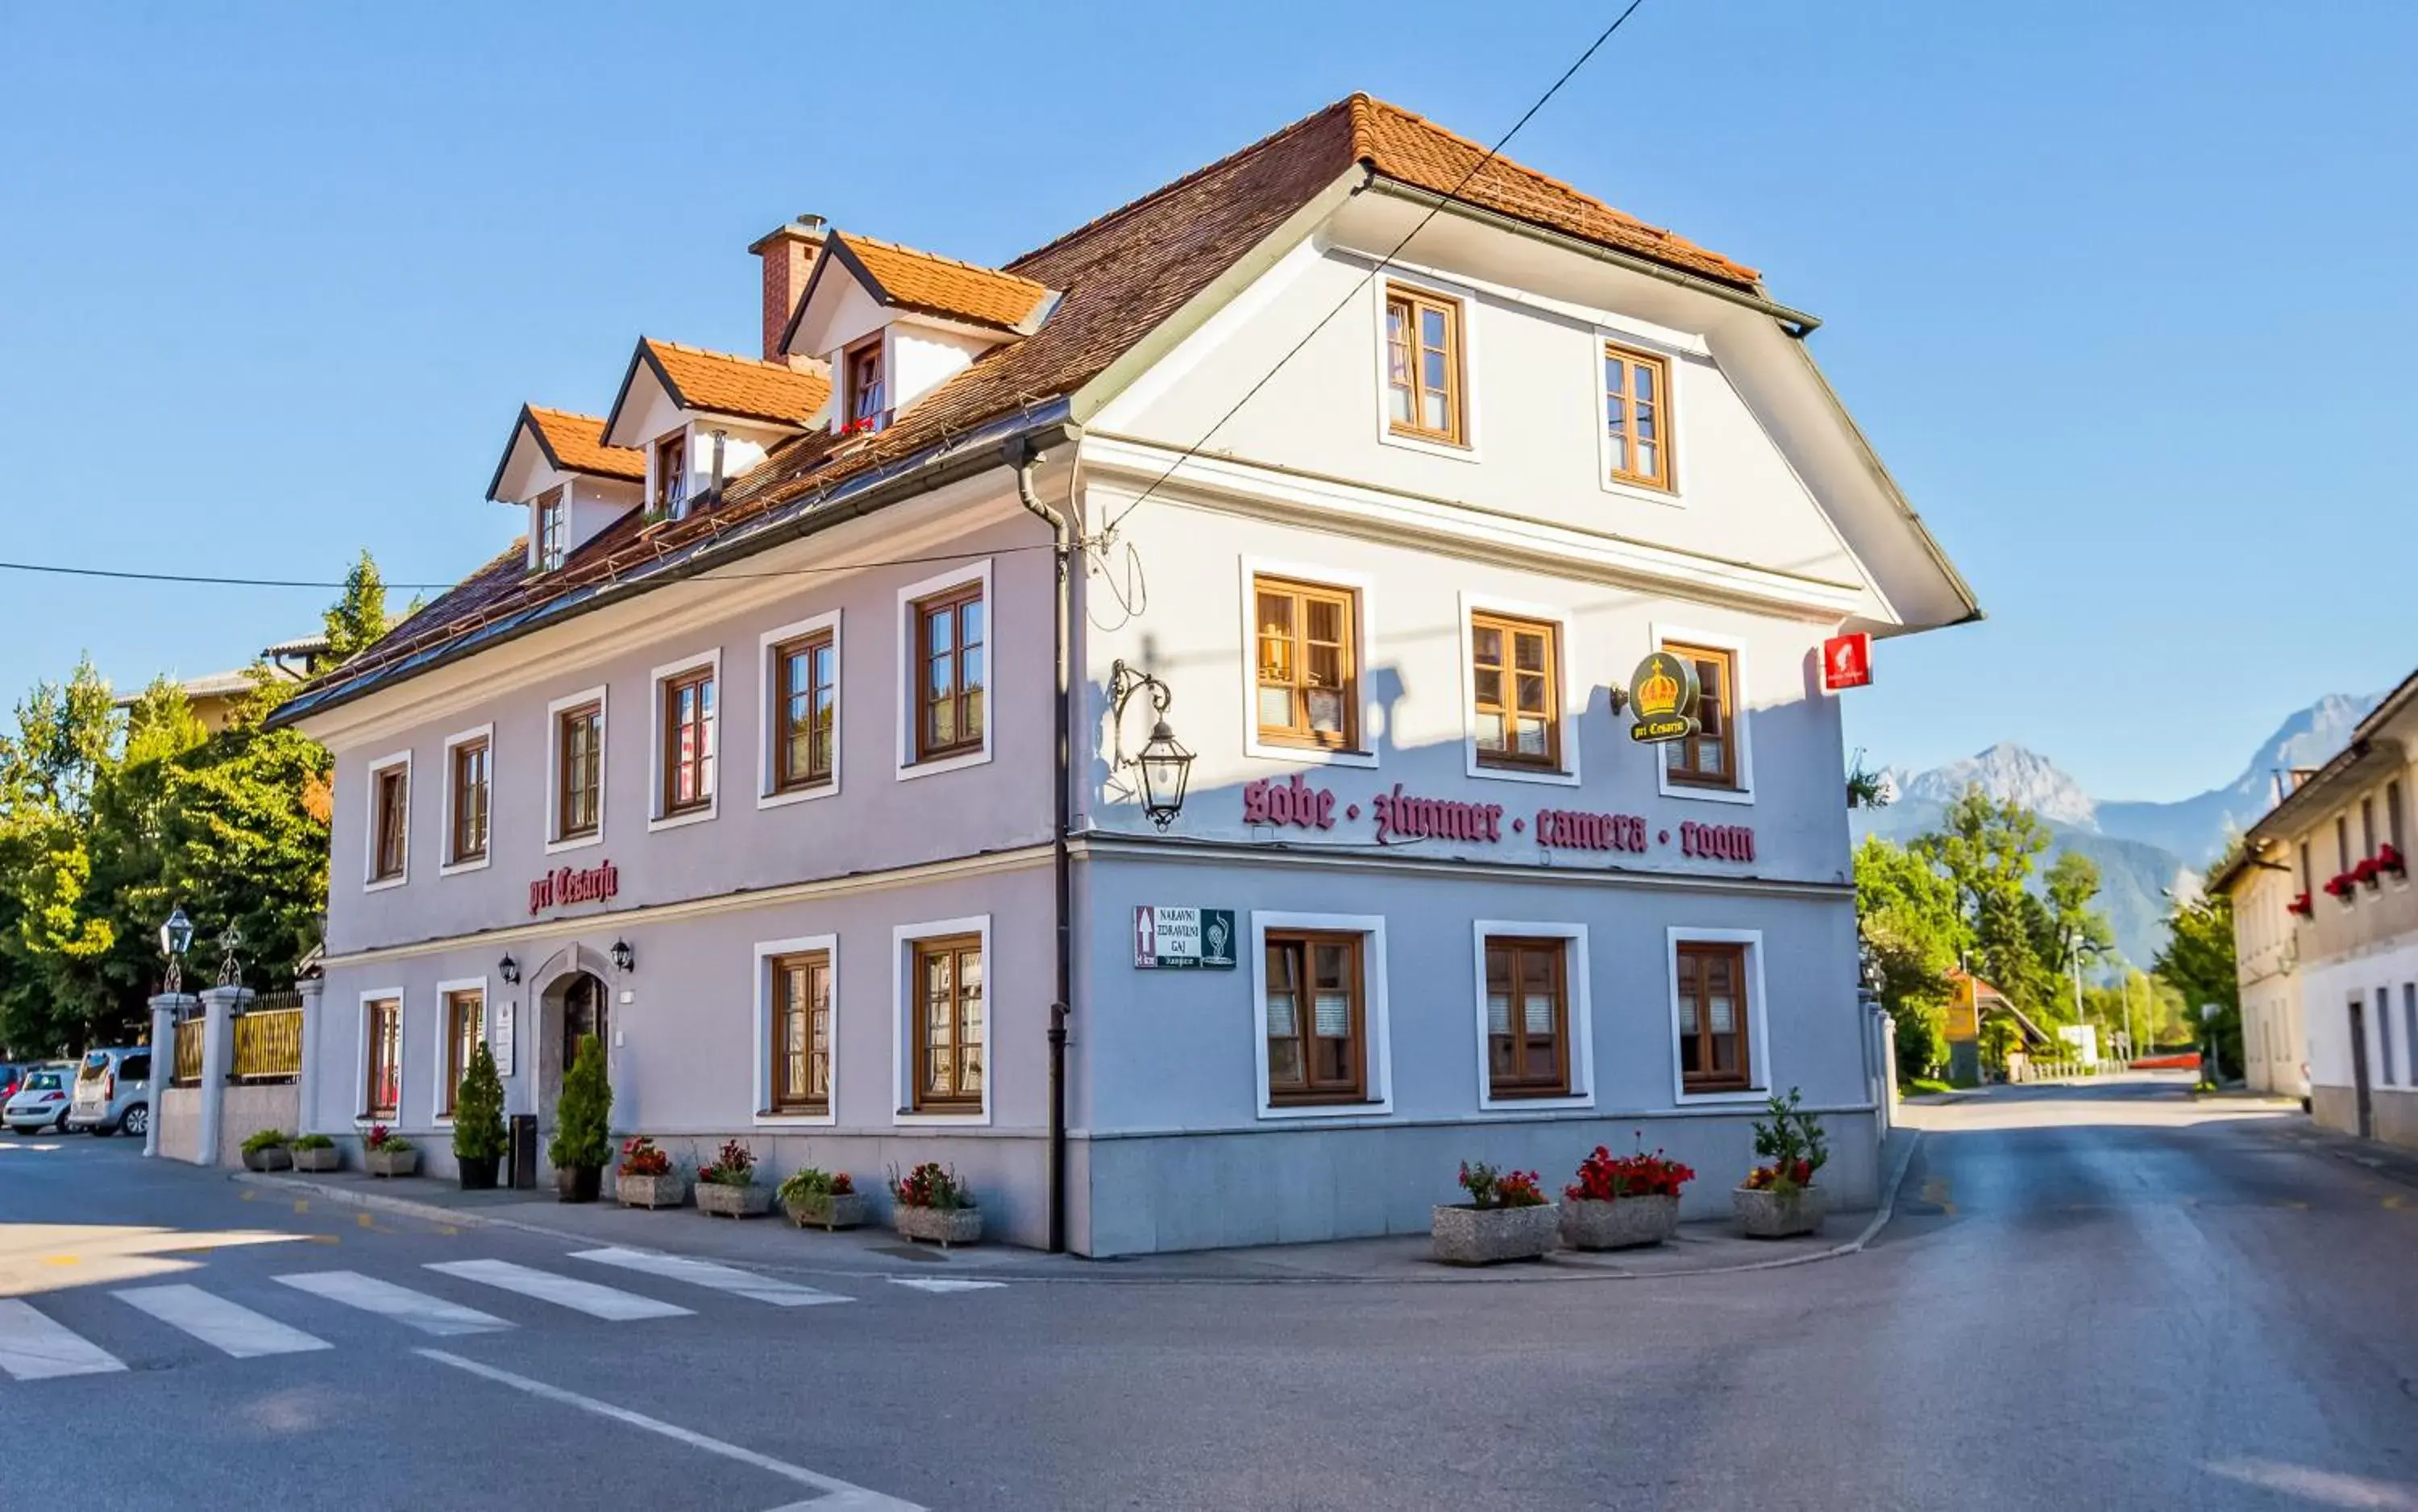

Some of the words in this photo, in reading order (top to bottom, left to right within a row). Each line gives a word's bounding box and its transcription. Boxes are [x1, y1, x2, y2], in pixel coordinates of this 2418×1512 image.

[1635, 727, 1647, 739] pri
[1373, 783, 1504, 845] zimmer
[1536, 808, 1648, 854] camera
[1680, 820, 1755, 862] room
[529, 870, 555, 916] pri
[555, 859, 618, 904] Cesarju
